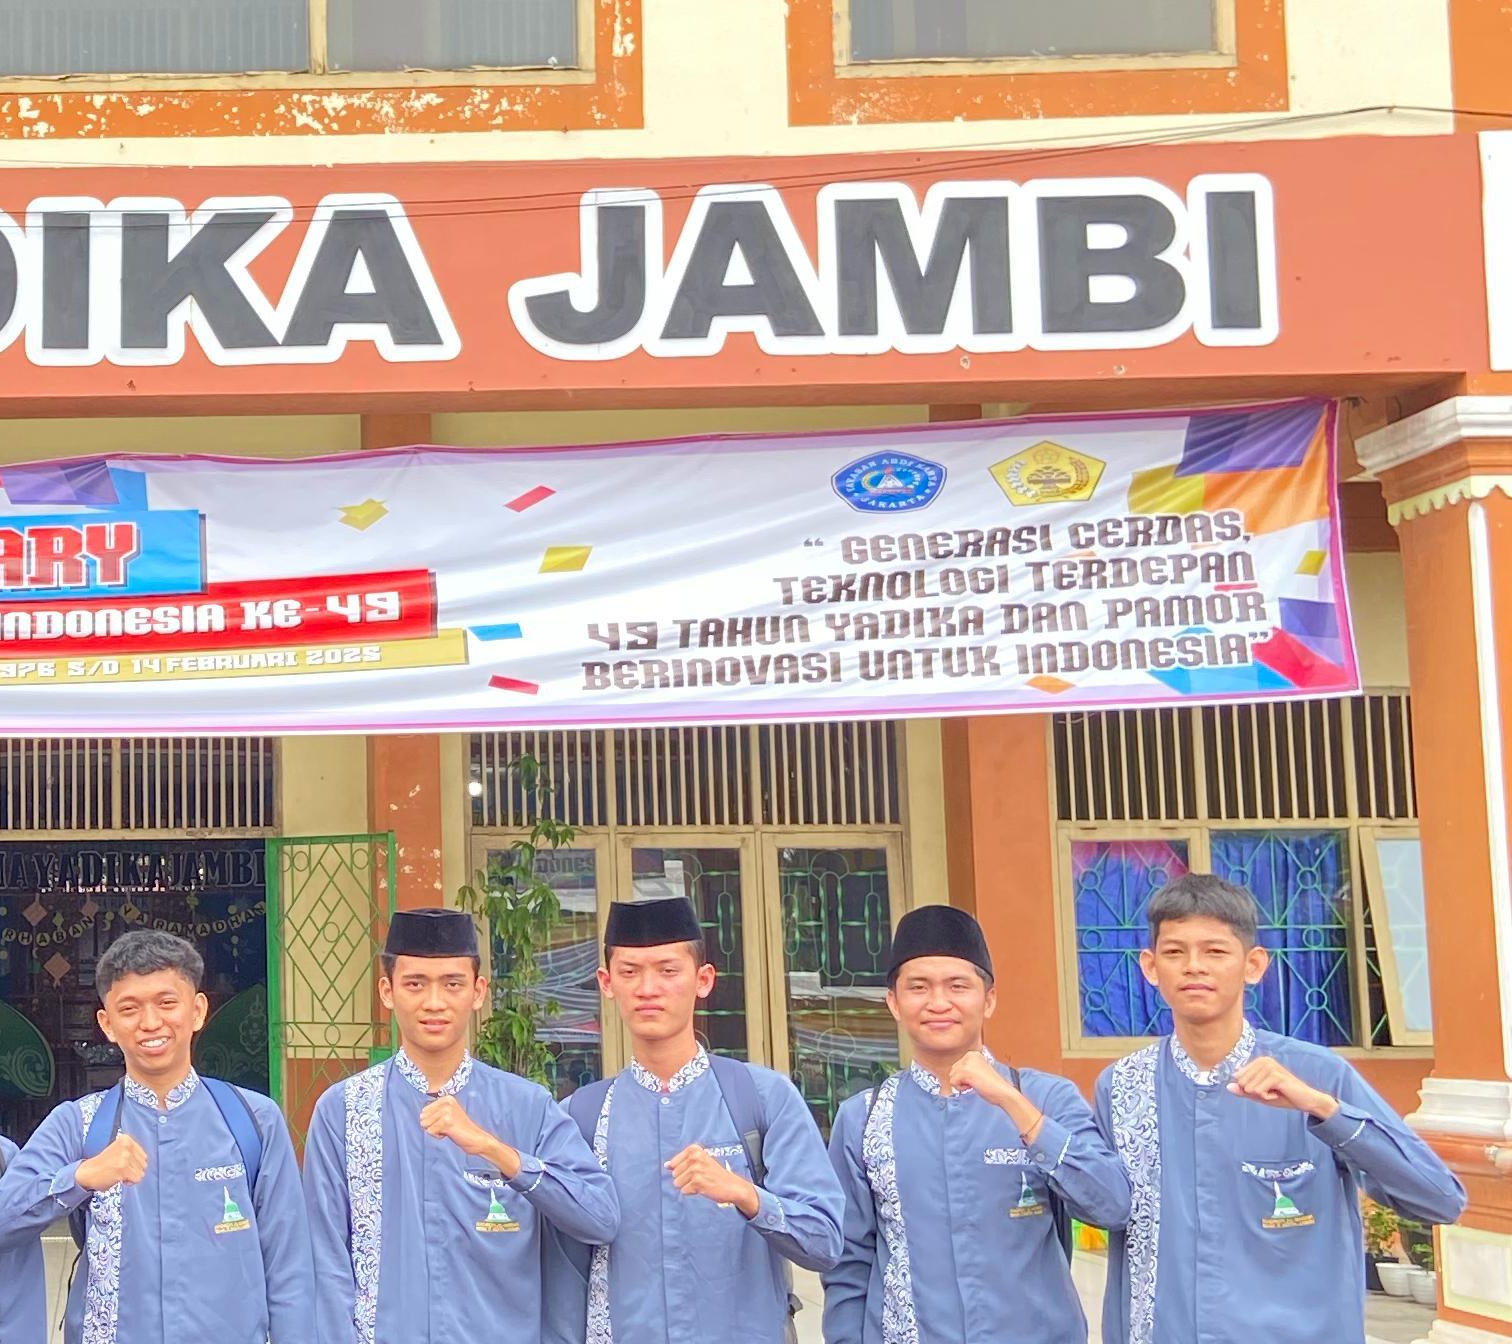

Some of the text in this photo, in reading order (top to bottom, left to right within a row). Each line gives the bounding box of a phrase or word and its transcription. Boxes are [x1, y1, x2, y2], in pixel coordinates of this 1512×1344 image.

[523, 190, 1263, 345] JAMBI
[860, 494, 926, 509] JAKARTA
[841, 524, 1053, 565] GENERASI
[1067, 510, 1251, 549] CERDAS,
[773, 551, 1256, 606] TEKNOLOGI TERDEPAN
[241, 591, 401, 631] KE-49
[586, 591, 1268, 652] 49 TAHUN YADIKA DAN PAMOR
[68, 660, 120, 677] S/D
[131, 657, 161, 674] 14
[166, 651, 298, 673] FEBRUARI
[306, 646, 382, 664] 2025
[582, 651, 842, 691] BERINOVASI
[858, 644, 1001, 681] UNTUK
[123, 905, 146, 923] YA
